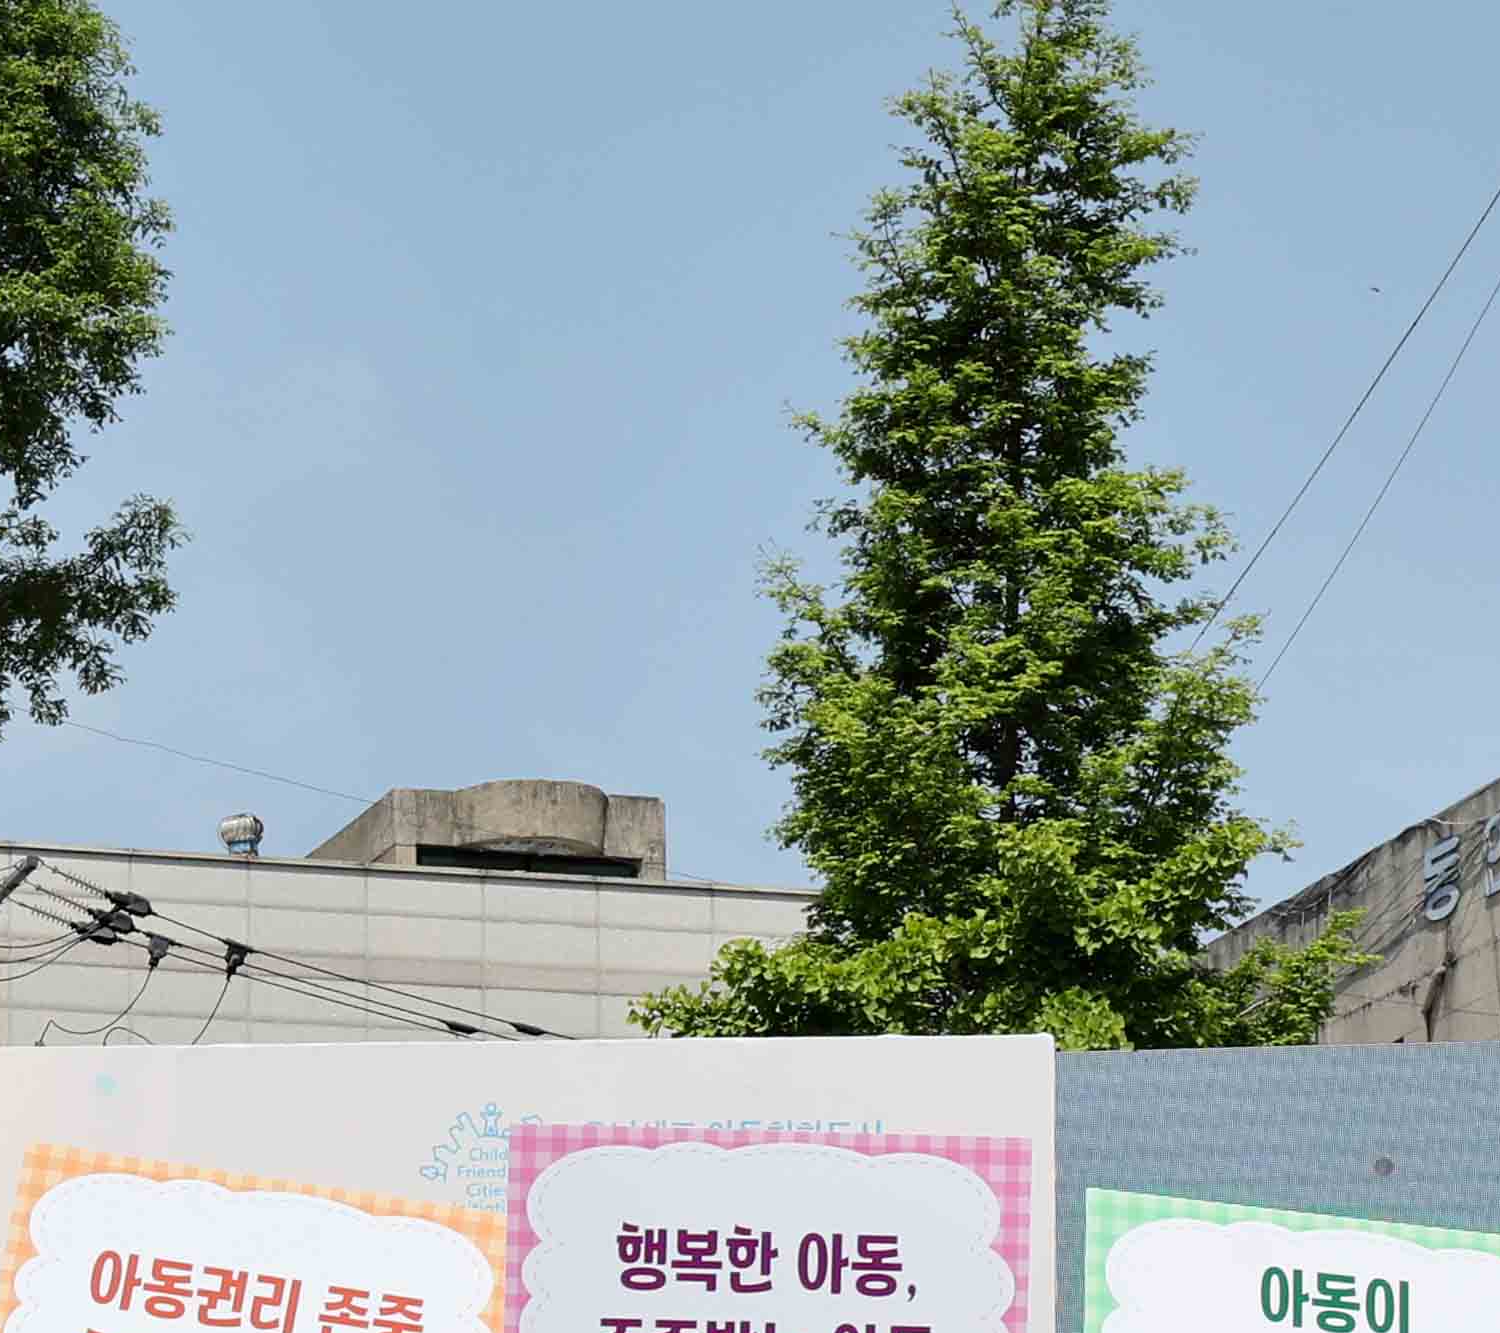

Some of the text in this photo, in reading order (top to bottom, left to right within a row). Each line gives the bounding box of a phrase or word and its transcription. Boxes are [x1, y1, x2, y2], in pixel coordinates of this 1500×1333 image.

[457, 1165, 506, 1179] Friend
[466, 1183, 506, 1198] Citie
[617, 1222, 916, 1301] 행복한 아동,
